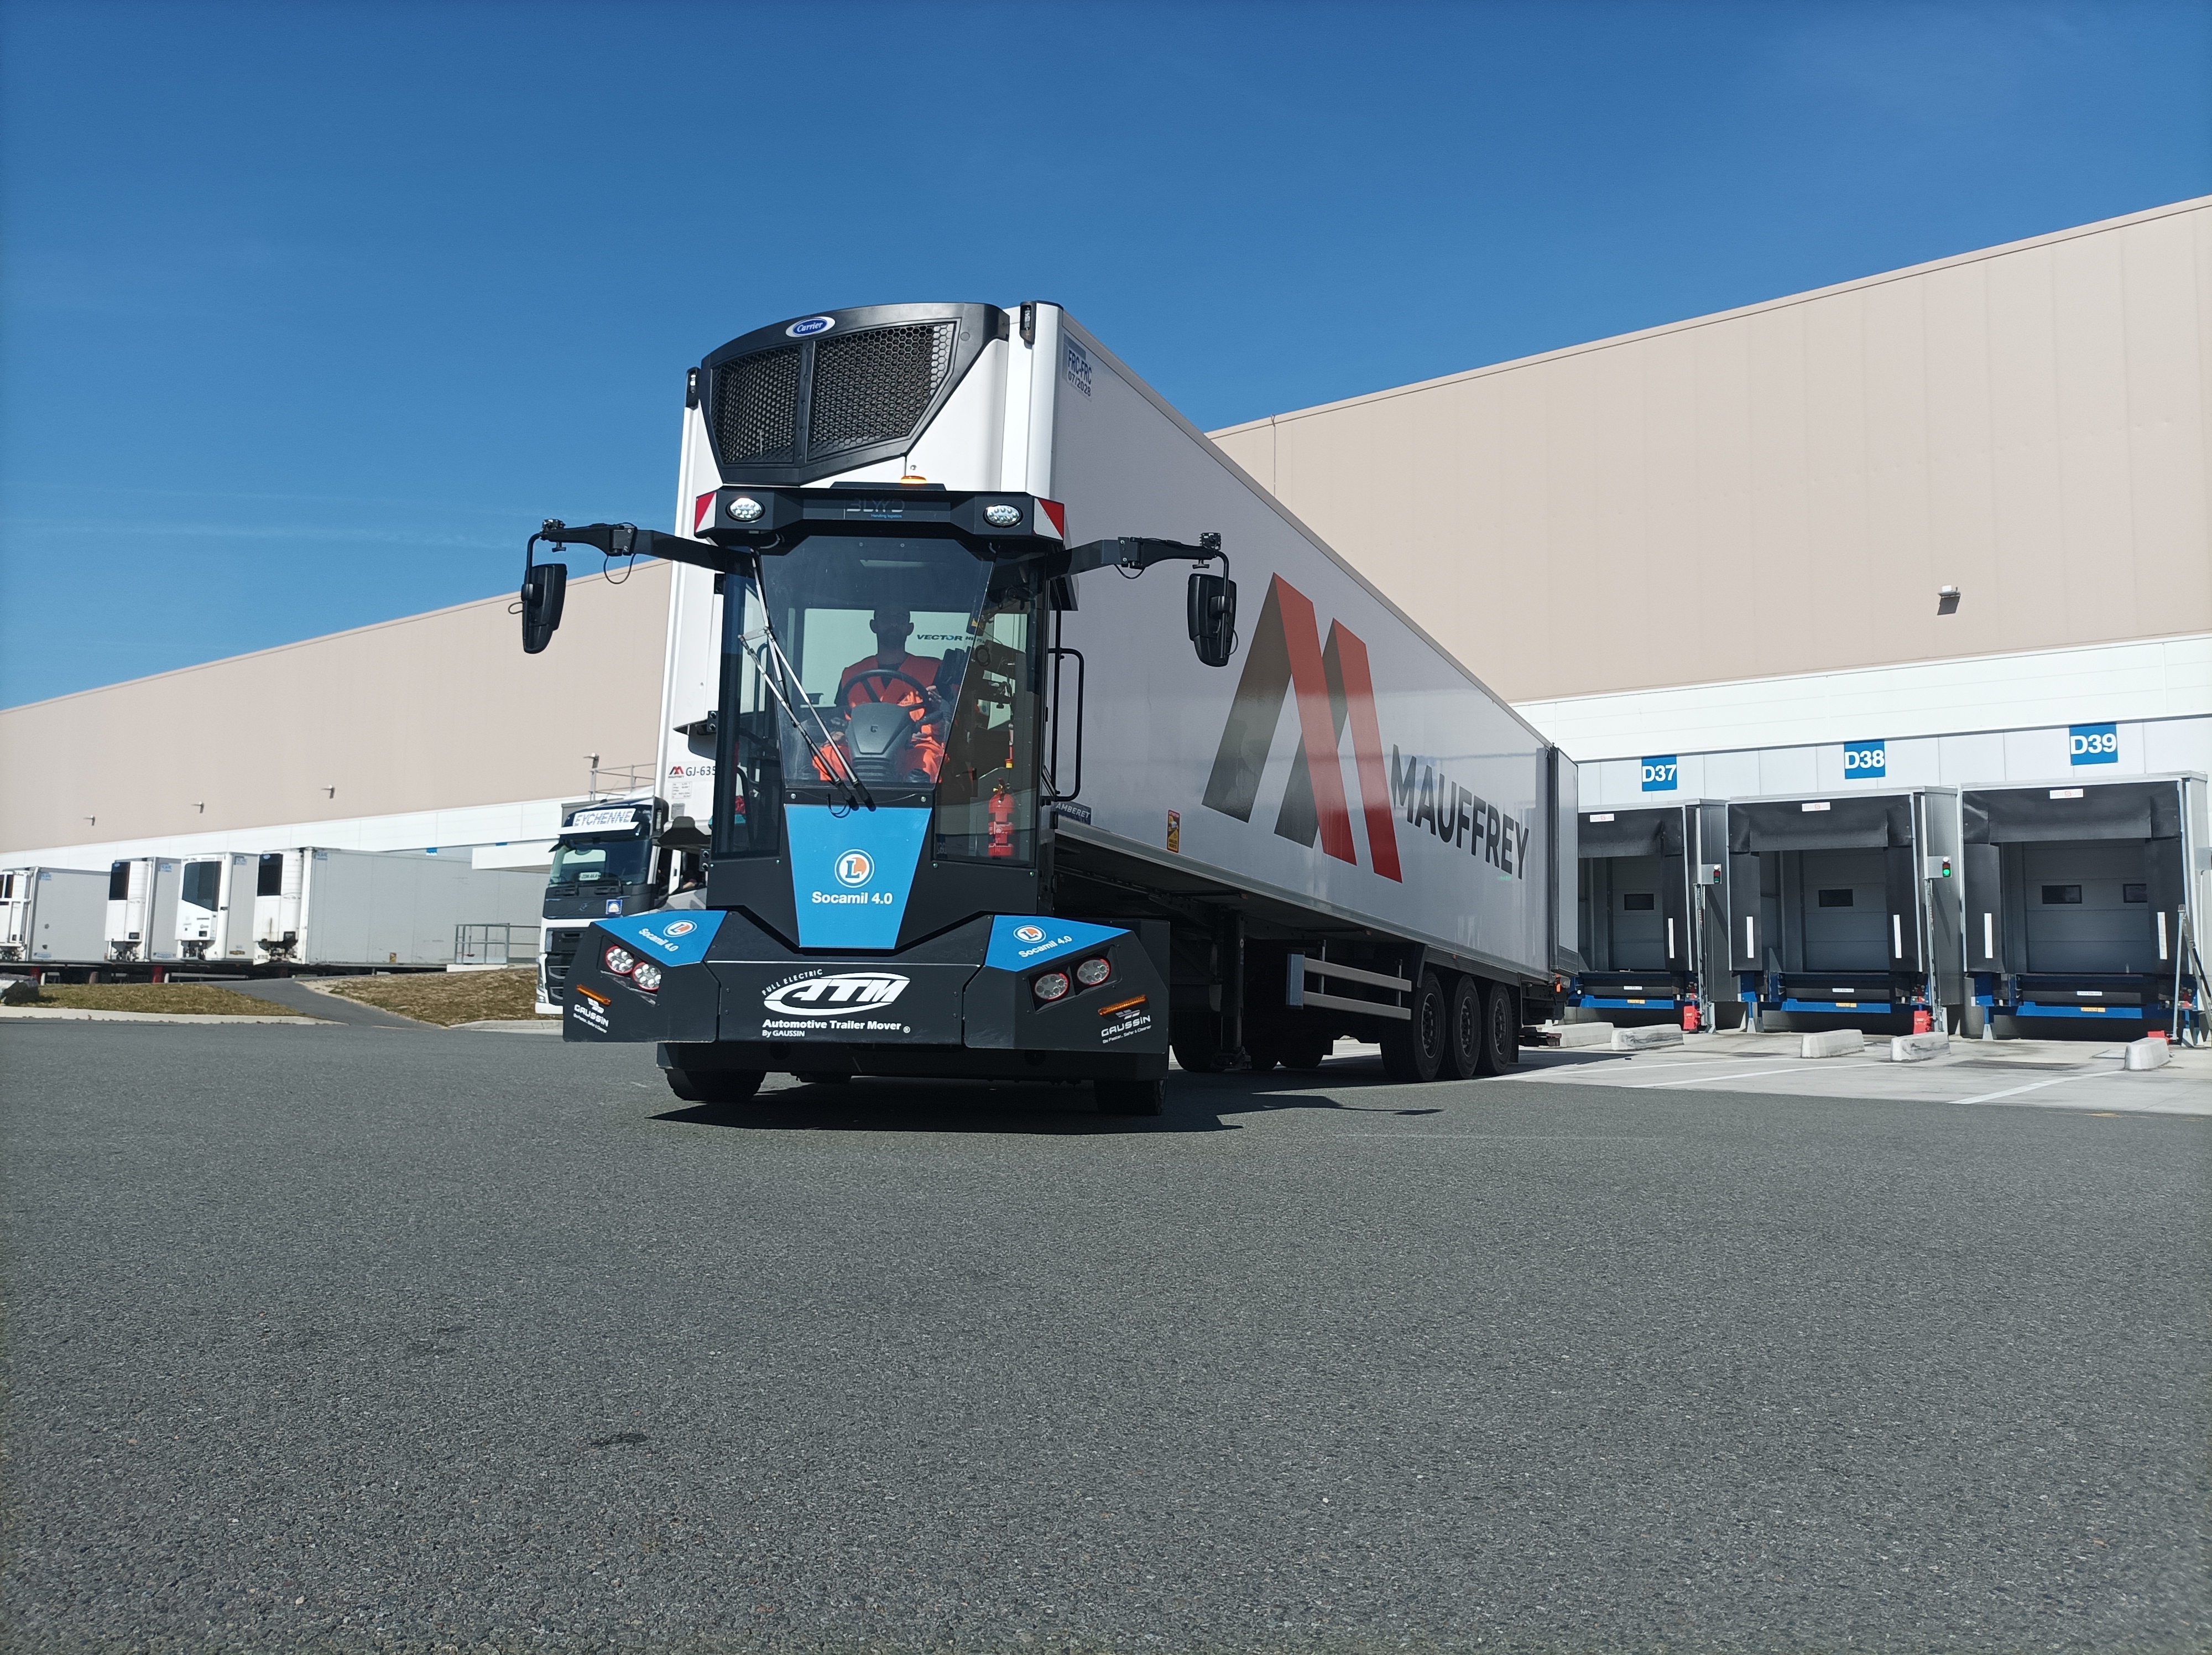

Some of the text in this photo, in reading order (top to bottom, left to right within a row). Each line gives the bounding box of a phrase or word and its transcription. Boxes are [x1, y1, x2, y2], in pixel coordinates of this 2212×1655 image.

[797, 322, 823, 332] Carrier
[1068, 349, 1092, 384] FRC-FRC
[1068, 371, 1091, 397] 07/2028
[2070, 733, 2117, 754] D39
[1844, 750, 1885, 769] D38
[1642, 764, 1677, 782] D37
[574, 810, 633, 827] EYCHENNE
[1391, 743, 1529, 880] MAUFFREY
[812, 891, 893, 904] Socamil 4.0
[638, 928, 679, 952] Socamil 4.0
[1018, 935, 1072, 957] Socamil 4.0
[761, 969, 823, 996] FULL ELECTRIC
[574, 1004, 609, 1027] GAUSSIN
[762, 1019, 827, 1029] Automotive
[830, 1021, 865, 1029] Trailer
[867, 1021, 901, 1030] Mover
[1101, 1015, 1151, 1037] GAUSSIN
